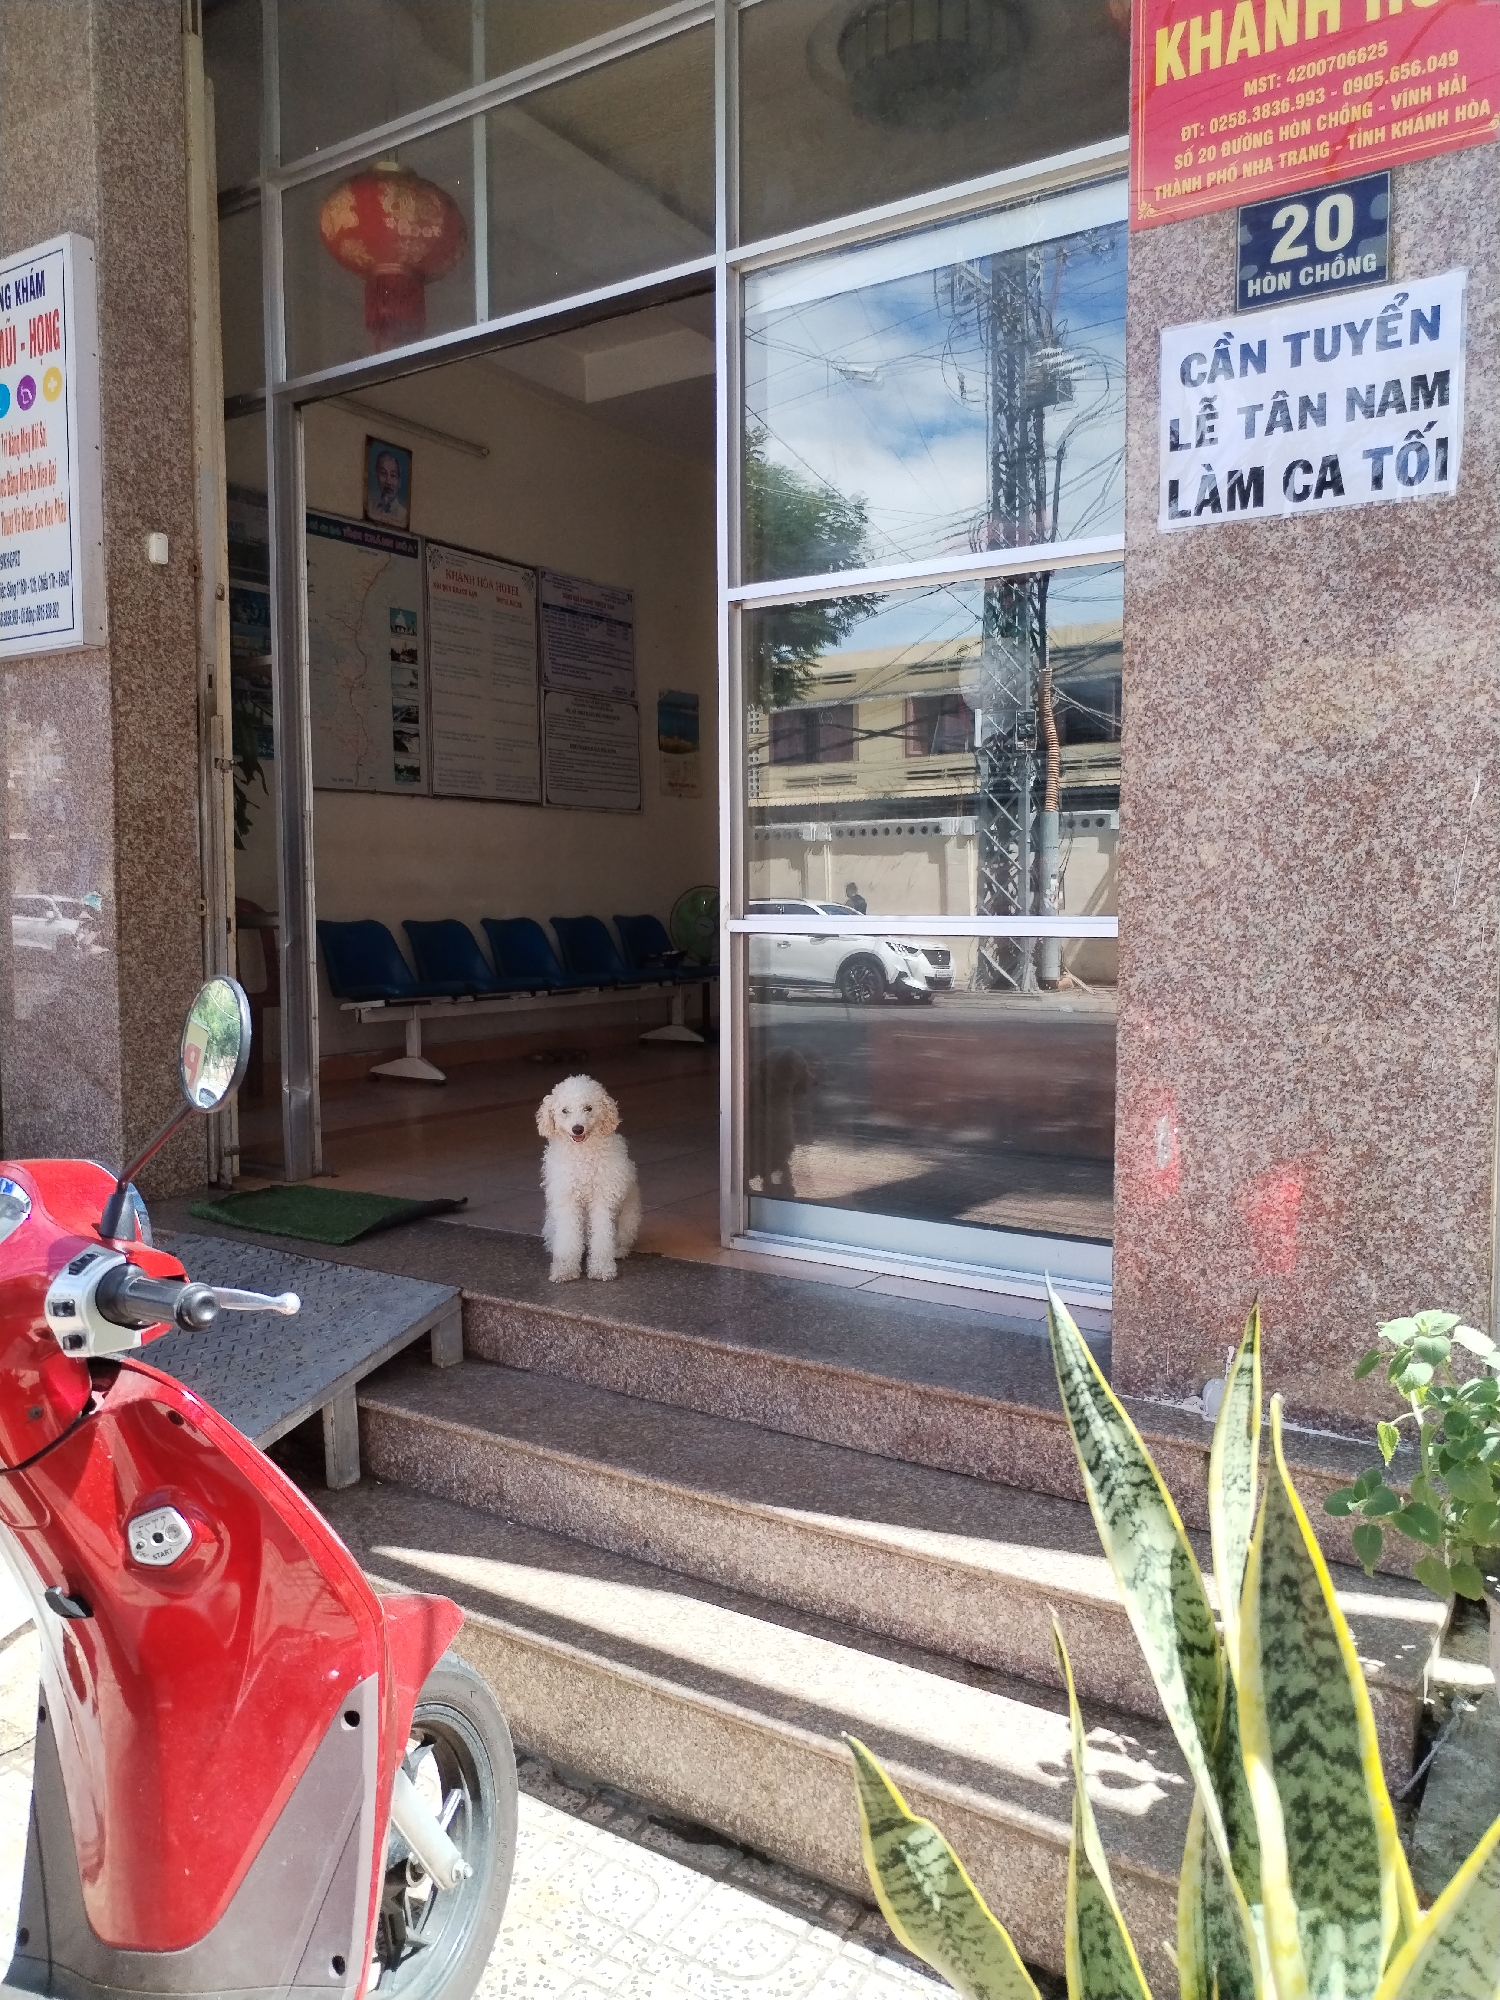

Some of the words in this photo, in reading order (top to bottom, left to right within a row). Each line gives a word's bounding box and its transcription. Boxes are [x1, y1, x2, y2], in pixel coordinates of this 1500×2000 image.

[1180, 122, 1205, 142] ĐT:
[1209, 86, 1326, 134] 0258.3836.993
[1342, 49, 1459, 96] 0905.656.049
[1243, 72, 1281, 98] MST:
[1286, 40, 1388, 84] 4200706625
[1153, 174, 1202, 202] THÀNH
[1206, 159, 1239, 188] PHỐ
[1242, 156, 1274, 179] NHA
[1278, 141, 1330, 169] TRANG
[1347, 124, 1386, 150] TỈNH
[1390, 108, 1449, 141] KHÁNH
[1454, 98, 1491, 124] HÒA
[1174, 144, 1195, 171] SỐ
[1197, 144, 1217, 165] 20
[1220, 128, 1274, 158] ĐƯỜNG
[1278, 117, 1311, 142] HÒN
[1316, 101, 1373, 132] CHỒNG
[1390, 84, 1432, 111] VĨNH
[1437, 72, 1467, 98] HẢI
[1269, 192, 1355, 265] 20
[14, 267, 46, 307] KHÁM
[1246, 267, 1292, 299] HÒN
[1298, 252, 1378, 287] CHỒNG
[28, 308, 61, 366] HỌNG
[1179, 331, 1267, 388] CẦN
[1282, 292, 1442, 369] TUYỂN
[1168, 394, 1219, 453] LỄ
[1236, 389, 1327, 440] TÂN
[1345, 368, 1451, 423] NAM
[1167, 462, 1265, 521] LÀM
[1282, 453, 1346, 503] CA
[1362, 420, 1449, 492] TỐI
[445, 568, 475, 586] KHÁNH
[495, 581, 521, 597] HOTEL
[152, 1547, 173, 1561] START
